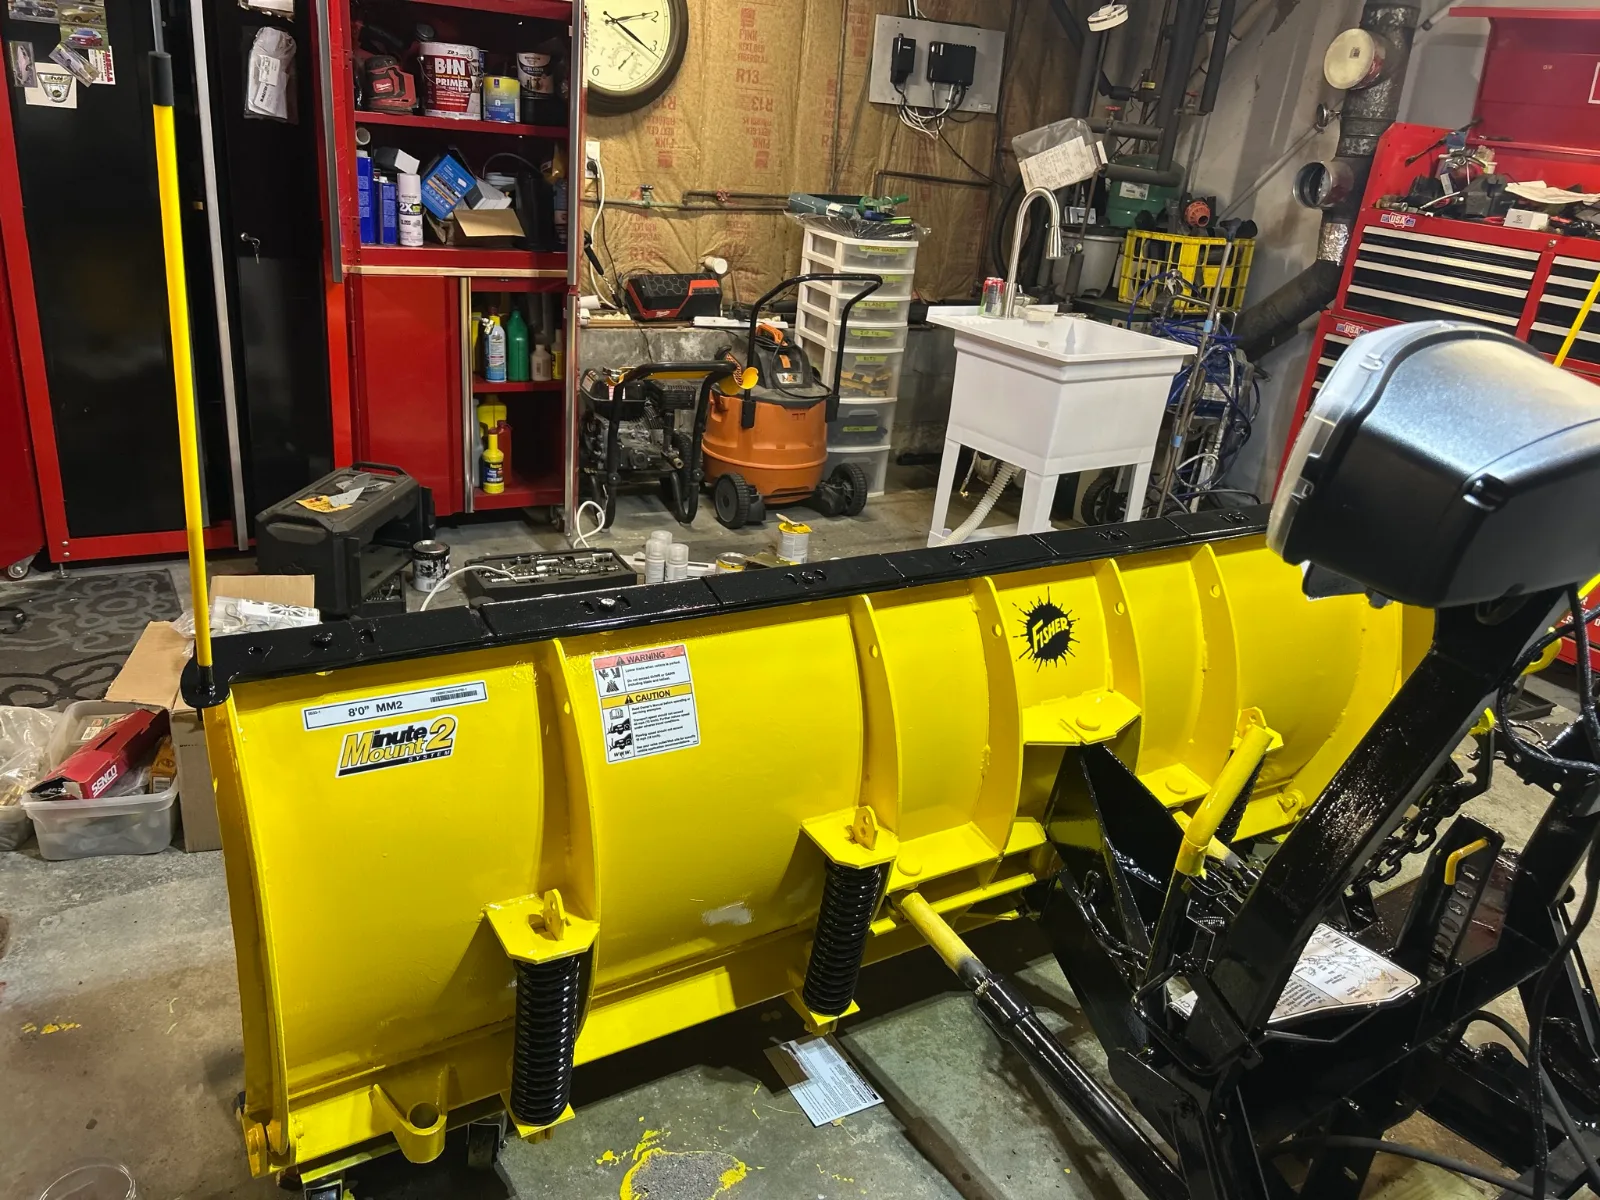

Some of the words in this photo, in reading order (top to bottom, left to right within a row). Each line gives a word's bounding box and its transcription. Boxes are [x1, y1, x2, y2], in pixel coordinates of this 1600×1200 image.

[651, 11, 659, 23] 2
[739, 28, 758, 41] PINK
[649, 40, 658, 51] 3
[592, 65, 601, 76] 6
[735, 68, 760, 85] R13
[435, 77, 469, 88] PRIMER
[751, 96, 774, 113] R13
[655, 138, 675, 149] PINK
[752, 138, 770, 149] PINK
[400, 202, 413, 213] 2X
[1390, 214, 1406, 225] USA
[1345, 324, 1359, 334] USA
[1032, 617, 1069, 654] FISHER
[626, 651, 666, 664] WARNING
[635, 690, 671, 702] CAUTION
[376, 700, 404, 713] MM2
[340, 724, 428, 768] Minute
[425, 716, 456, 752] 2
[407, 750, 451, 763] SYSTEM
[613, 749, 632, 758] www.
[91, 764, 118, 795] SENCO
